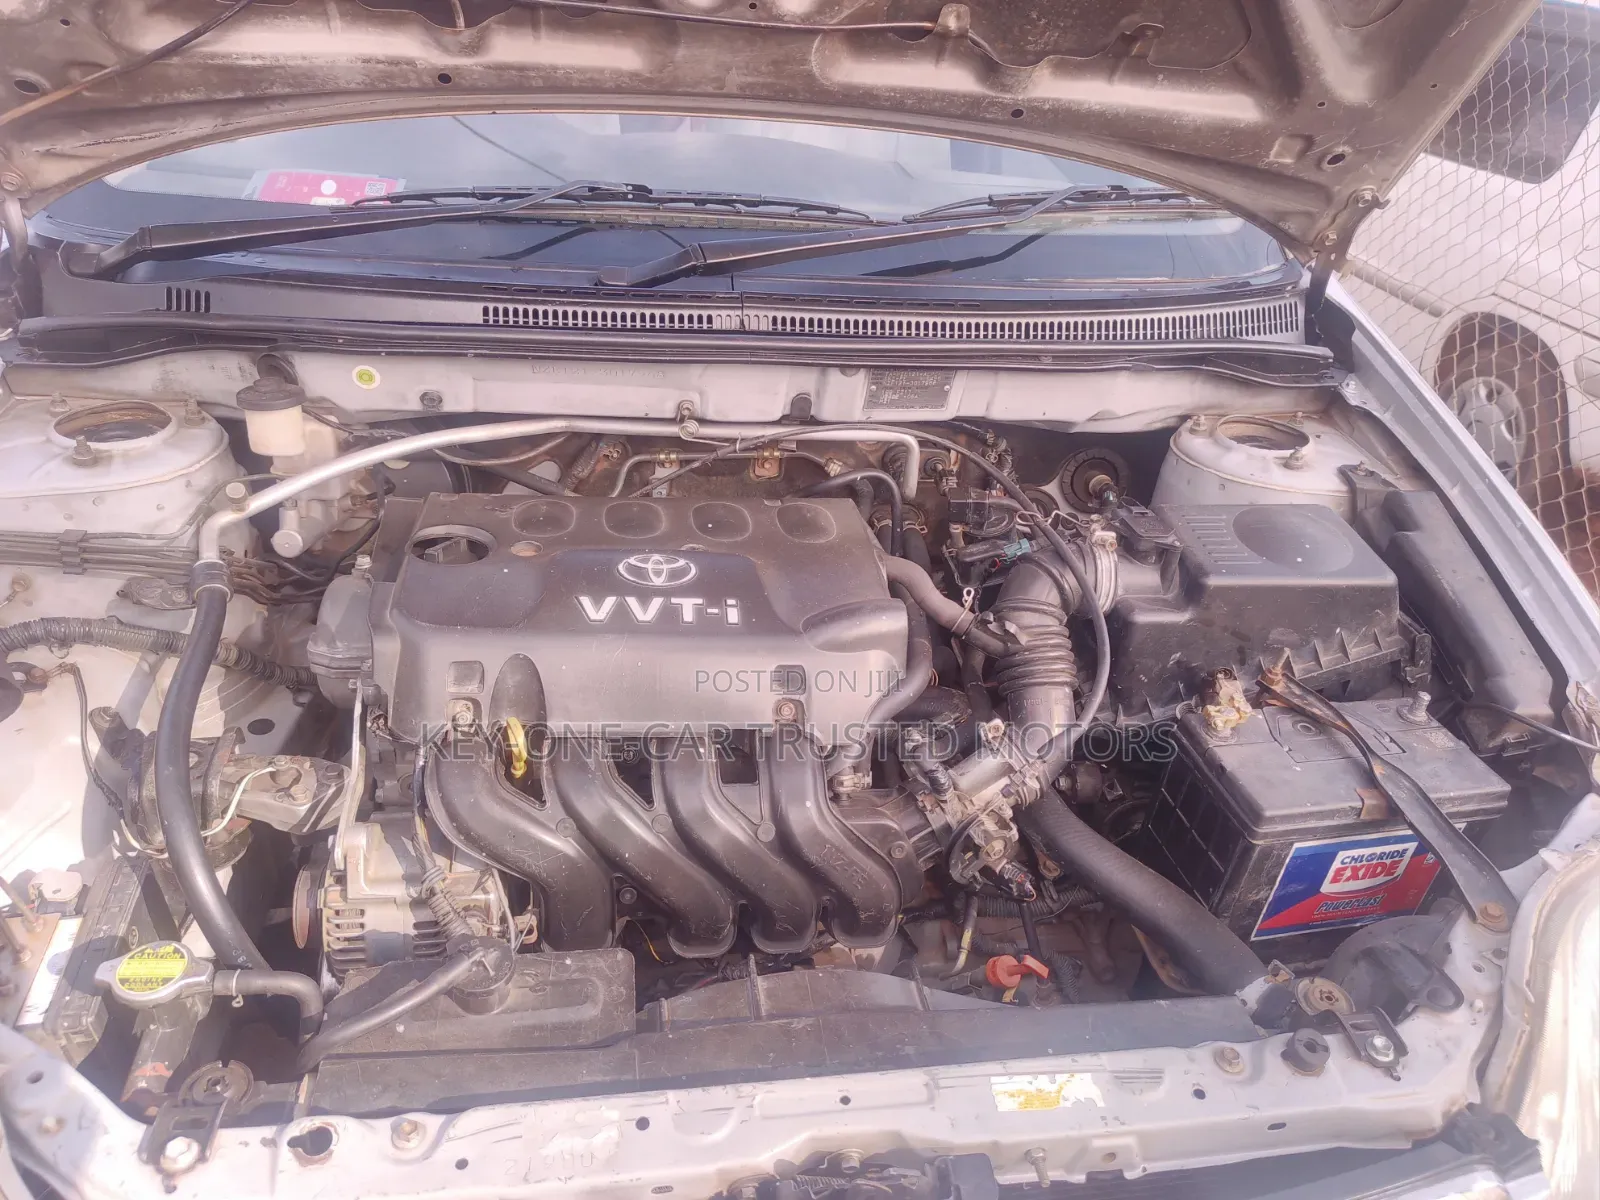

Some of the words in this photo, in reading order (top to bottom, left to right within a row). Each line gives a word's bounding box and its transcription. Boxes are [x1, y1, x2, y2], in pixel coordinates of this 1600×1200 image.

[574, 596, 740, 625] VVT-i
[1340, 848, 1410, 865] CHLORIDE
[1330, 859, 1403, 884] EXIDE
